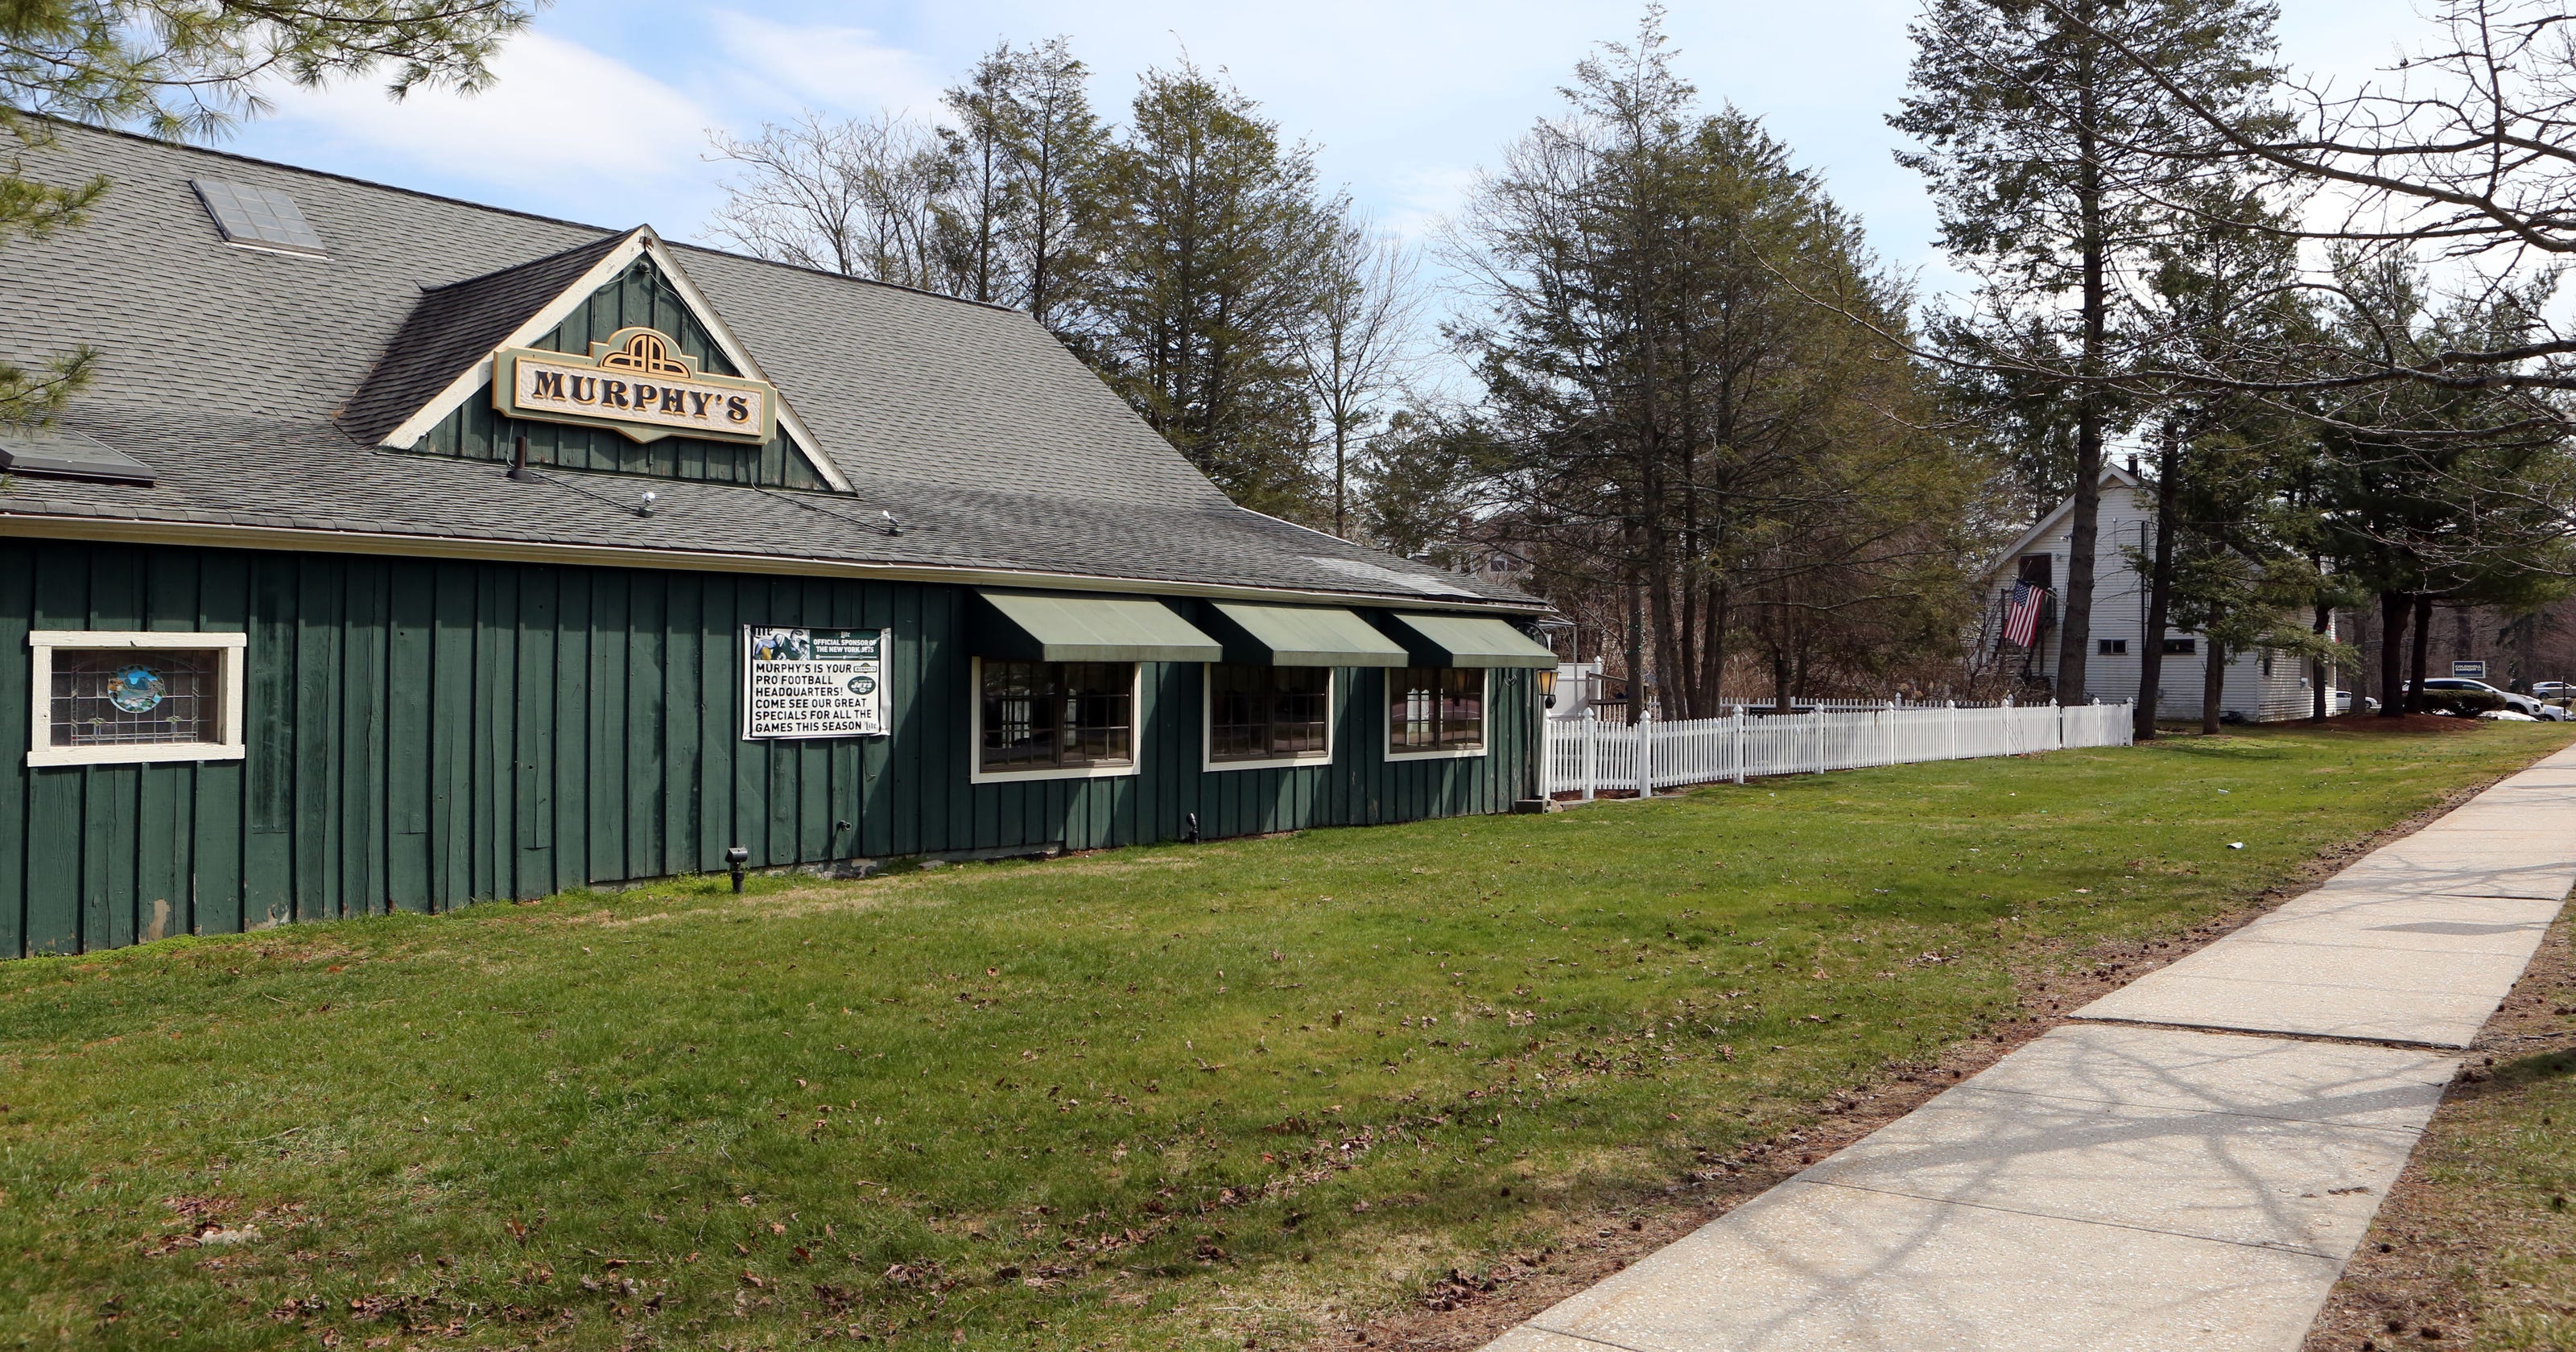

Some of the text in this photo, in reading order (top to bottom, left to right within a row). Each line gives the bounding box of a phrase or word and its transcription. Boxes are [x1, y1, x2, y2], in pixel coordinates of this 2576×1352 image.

[532, 370, 749, 423] MURPHY'S
[756, 663, 852, 673] MURPHY'S IS YOUR
[756, 675, 833, 685] PRO FOOTBALL
[756, 687, 843, 697] HEADQUARTERS!
[755, 698, 867, 709] COME SEE OUR GREAT
[755, 709, 872, 720] SPECIALS FOR ALL THE
[755, 721, 861, 732] GAMES THIS SEASON
[865, 721, 877, 731] Lite
